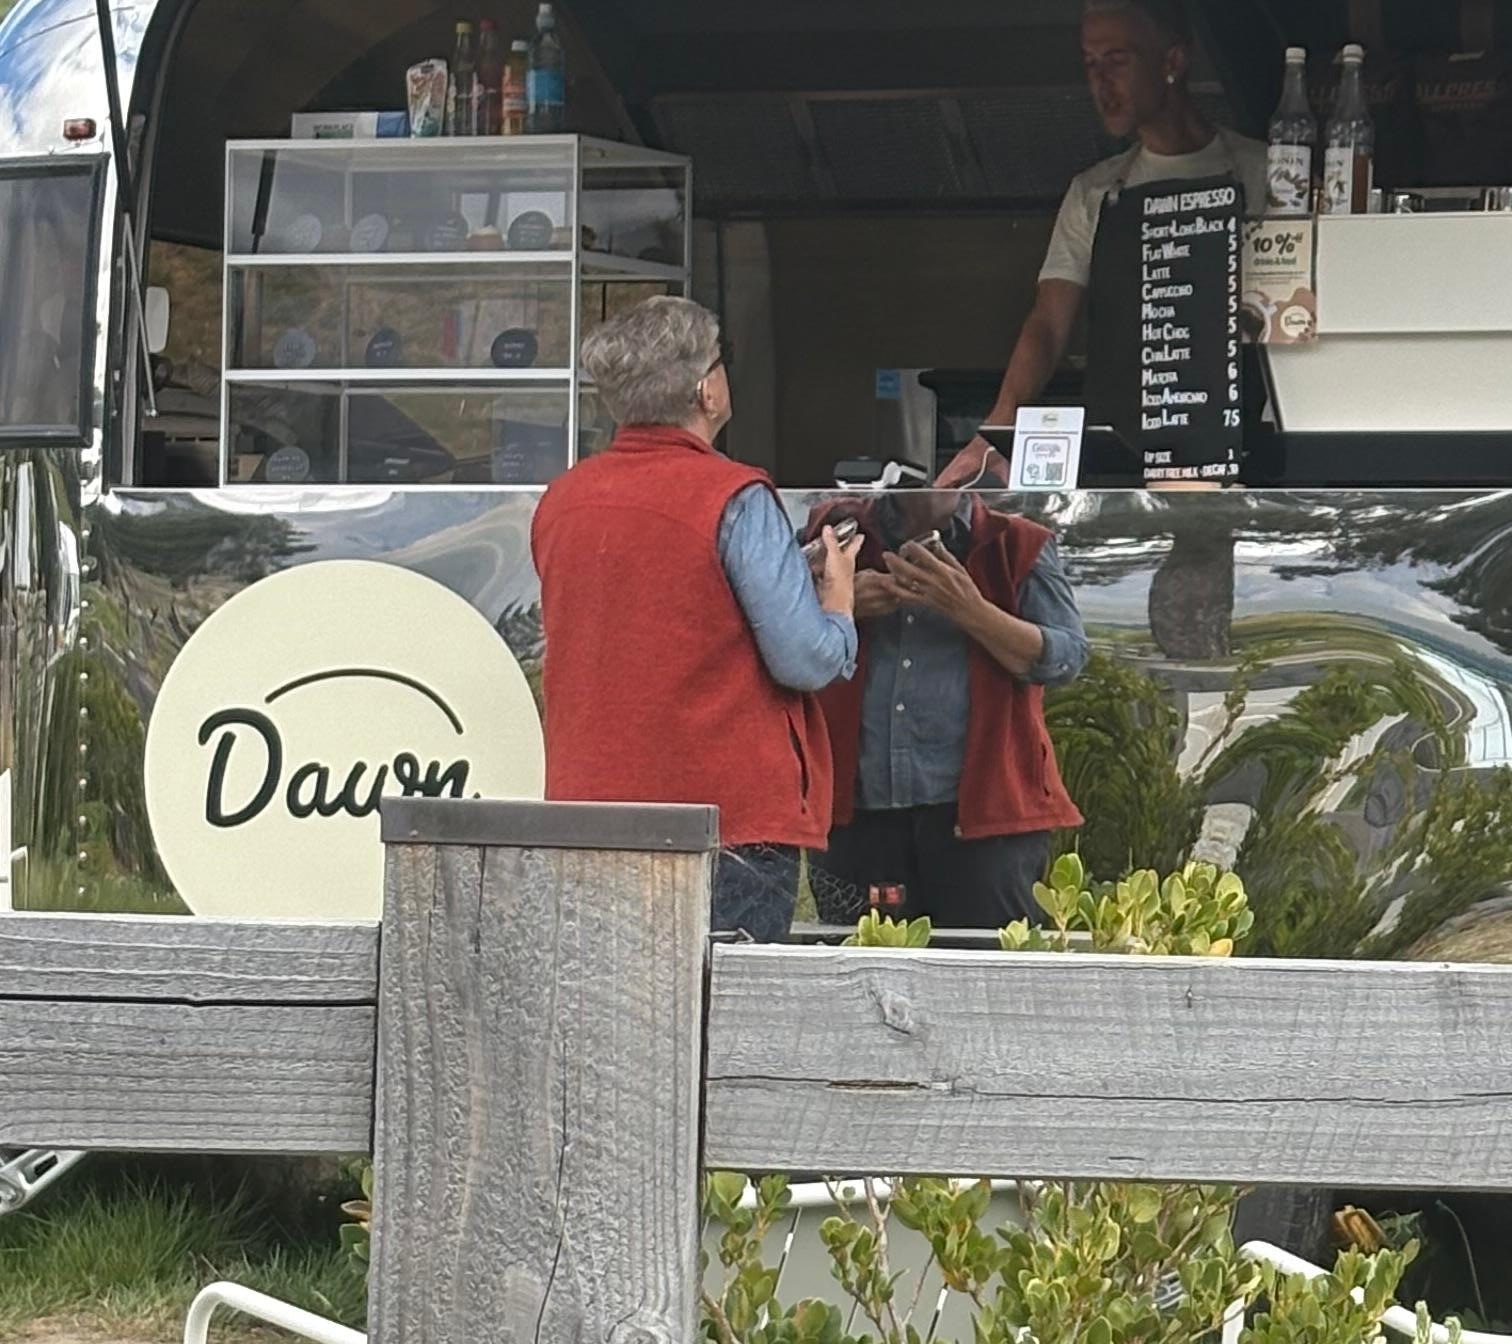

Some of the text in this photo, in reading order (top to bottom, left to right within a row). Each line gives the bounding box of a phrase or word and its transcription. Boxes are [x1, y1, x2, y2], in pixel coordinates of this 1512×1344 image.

[1180, 187, 1235, 211] ESPRESSO
[1227, 217, 1236, 232] 4
[1228, 234, 1237, 252] 5
[1252, 232, 1296, 255] 10%
[1143, 254, 1237, 281] LATTE 5
[1227, 274, 1237, 293] 5
[1142, 295, 1237, 321] MOCHA 5
[1227, 316, 1237, 334] 5
[1227, 339, 1237, 358] 5
[1227, 361, 1238, 380] 6
[1228, 383, 1239, 402] 6
[1227, 448, 1234, 461] 1
[198, 708, 481, 828] Dawn
